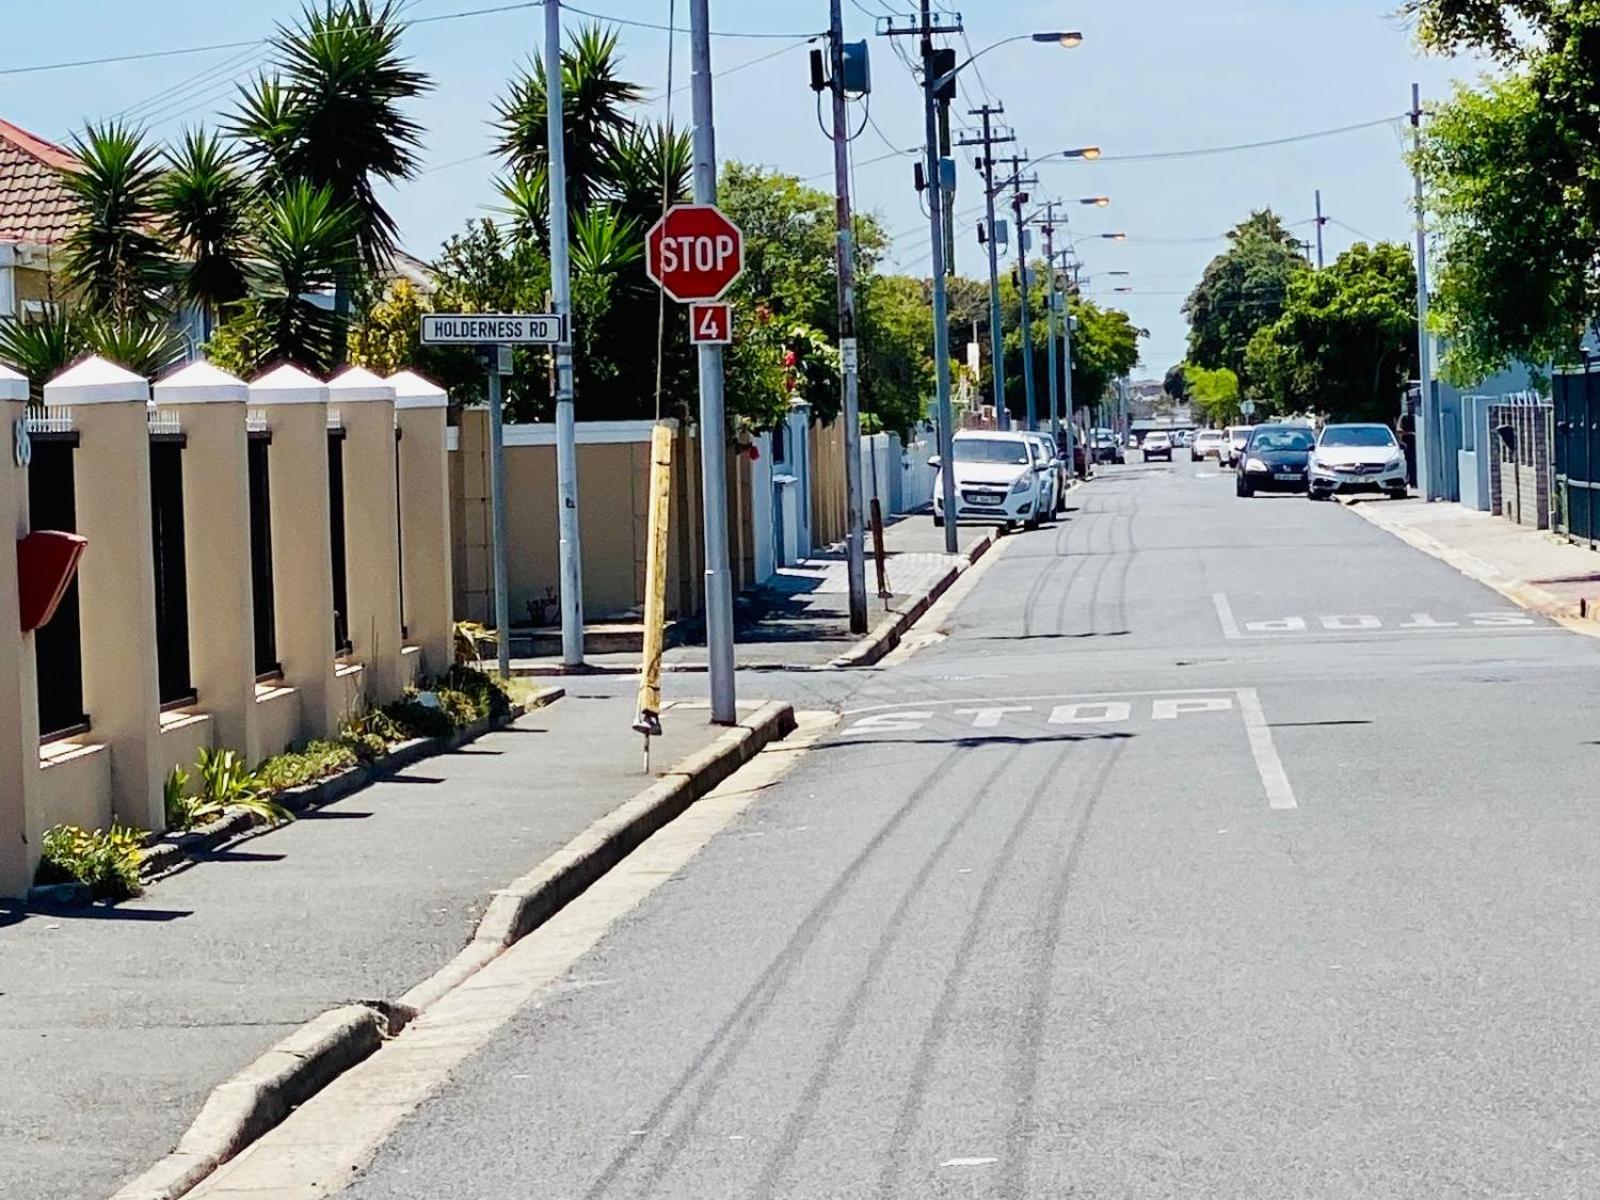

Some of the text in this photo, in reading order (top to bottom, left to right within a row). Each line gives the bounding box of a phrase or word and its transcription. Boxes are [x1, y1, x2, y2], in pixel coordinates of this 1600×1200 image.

[660, 235, 733, 272] STOP
[434, 320, 548, 338] HOLDERNESS RD
[699, 308, 719, 338] 4
[1245, 611, 1535, 631] STOP
[840, 698, 1233, 735] STOP
